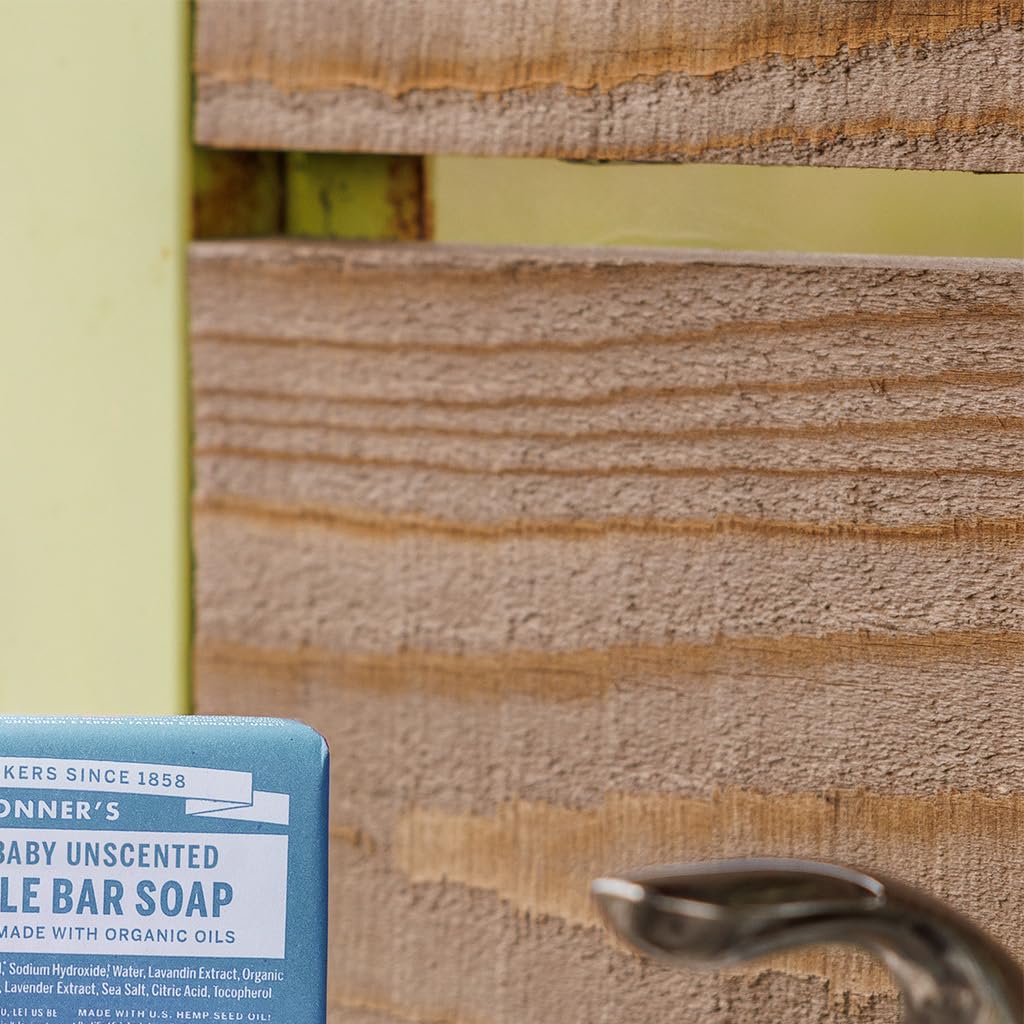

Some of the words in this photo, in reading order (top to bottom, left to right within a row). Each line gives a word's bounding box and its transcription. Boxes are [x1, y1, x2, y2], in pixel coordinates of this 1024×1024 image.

[66, 767, 130, 785] SINCE
[137, 771, 187, 789] 1858
[66, 842, 219, 869] UNSCENTED
[52, 877, 124, 916] BAR
[135, 879, 233, 918] SOAP
[52, 926, 98, 941] WITH
[105, 927, 188, 943] ORGANIC
[194, 929, 236, 944] OILS
[9, 962, 51, 976] Sodium
[112, 965, 146, 980] Water,
[148, 965, 197, 980] Lavandin
[198, 967, 241, 982] Extract,
[242, 968, 284, 984] Organic
[4, 980, 54, 994] Lavender
[57, 981, 99, 997] Extract,
[102, 982, 122, 996] Sea
[124, 983, 149, 997] Salt,
[151, 984, 181, 998] Citric
[184, 984, 211, 999] Acid,
[213, 985, 272, 1001] Tocopherol
[31, 1008, 44, 1017] US
[46, 1008, 58, 1018] BE
[78, 1008, 111, 1018] MADE
[115, 1009, 145, 1018] WITH
[149, 1010, 173, 1019] U.S.
[176, 1011, 210, 1020] HEMP
[213, 1011, 244, 1021] SEED
